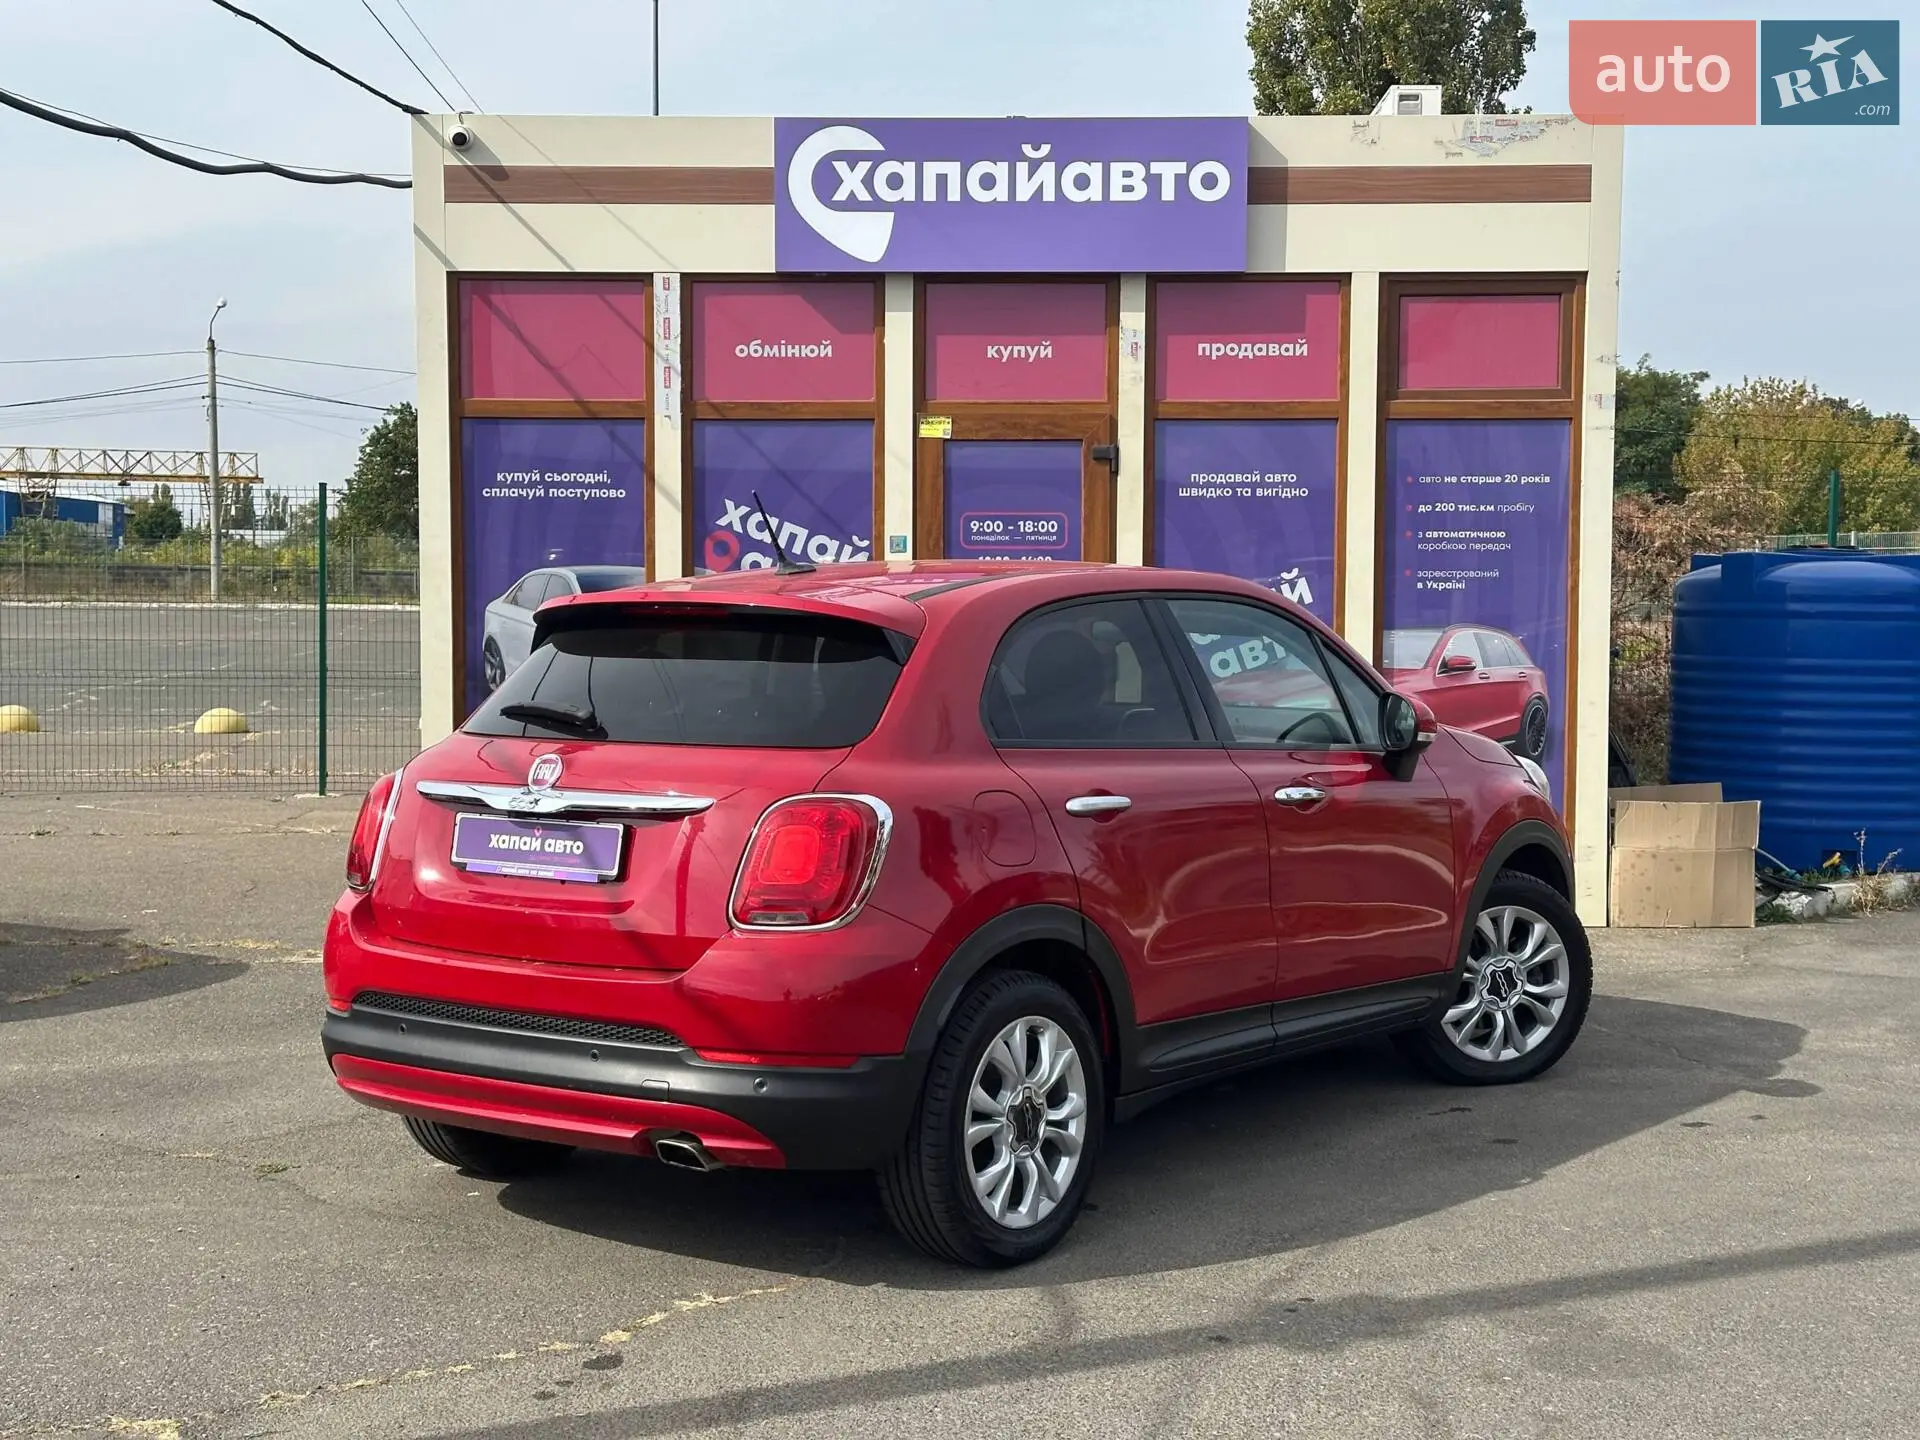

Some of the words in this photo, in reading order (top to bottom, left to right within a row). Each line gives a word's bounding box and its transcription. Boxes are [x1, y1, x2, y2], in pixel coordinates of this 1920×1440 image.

[735, 339, 832, 357] обмінюй
[987, 340, 1052, 362] купуй
[1197, 338, 1308, 360] продавай
[496, 470, 540, 484] купуй
[544, 470, 611, 484] сьогодні,
[1191, 470, 1260, 485] продавай
[1264, 473, 1297, 482] авто
[1419, 475, 1441, 483] авто
[1444, 475, 1458, 483] не
[1460, 475, 1502, 485] старше
[1504, 474, 1518, 483] 20
[1521, 474, 1551, 485] років
[482, 485, 545, 500] сплачуй
[549, 488, 626, 500] поступово
[1179, 487, 1232, 498] швидко
[1236, 487, 1251, 496] та
[1256, 485, 1309, 499] вигідно
[1417, 504, 1432, 513] до
[1434, 503, 1455, 512] 200
[1497, 502, 1535, 513] пробігу
[970, 520, 1003, 533] 9:00
[1017, 520, 1058, 533] 18:00
[971, 534, 1010, 542] понеділок
[1417, 541, 1467, 551] коробкою
[1469, 542, 1512, 551] передач
[1416, 569, 1499, 579] зареєстрований
[1417, 581, 1423, 589] в
[1426, 580, 1465, 591] Україні
[544, 837, 584, 855] авто
